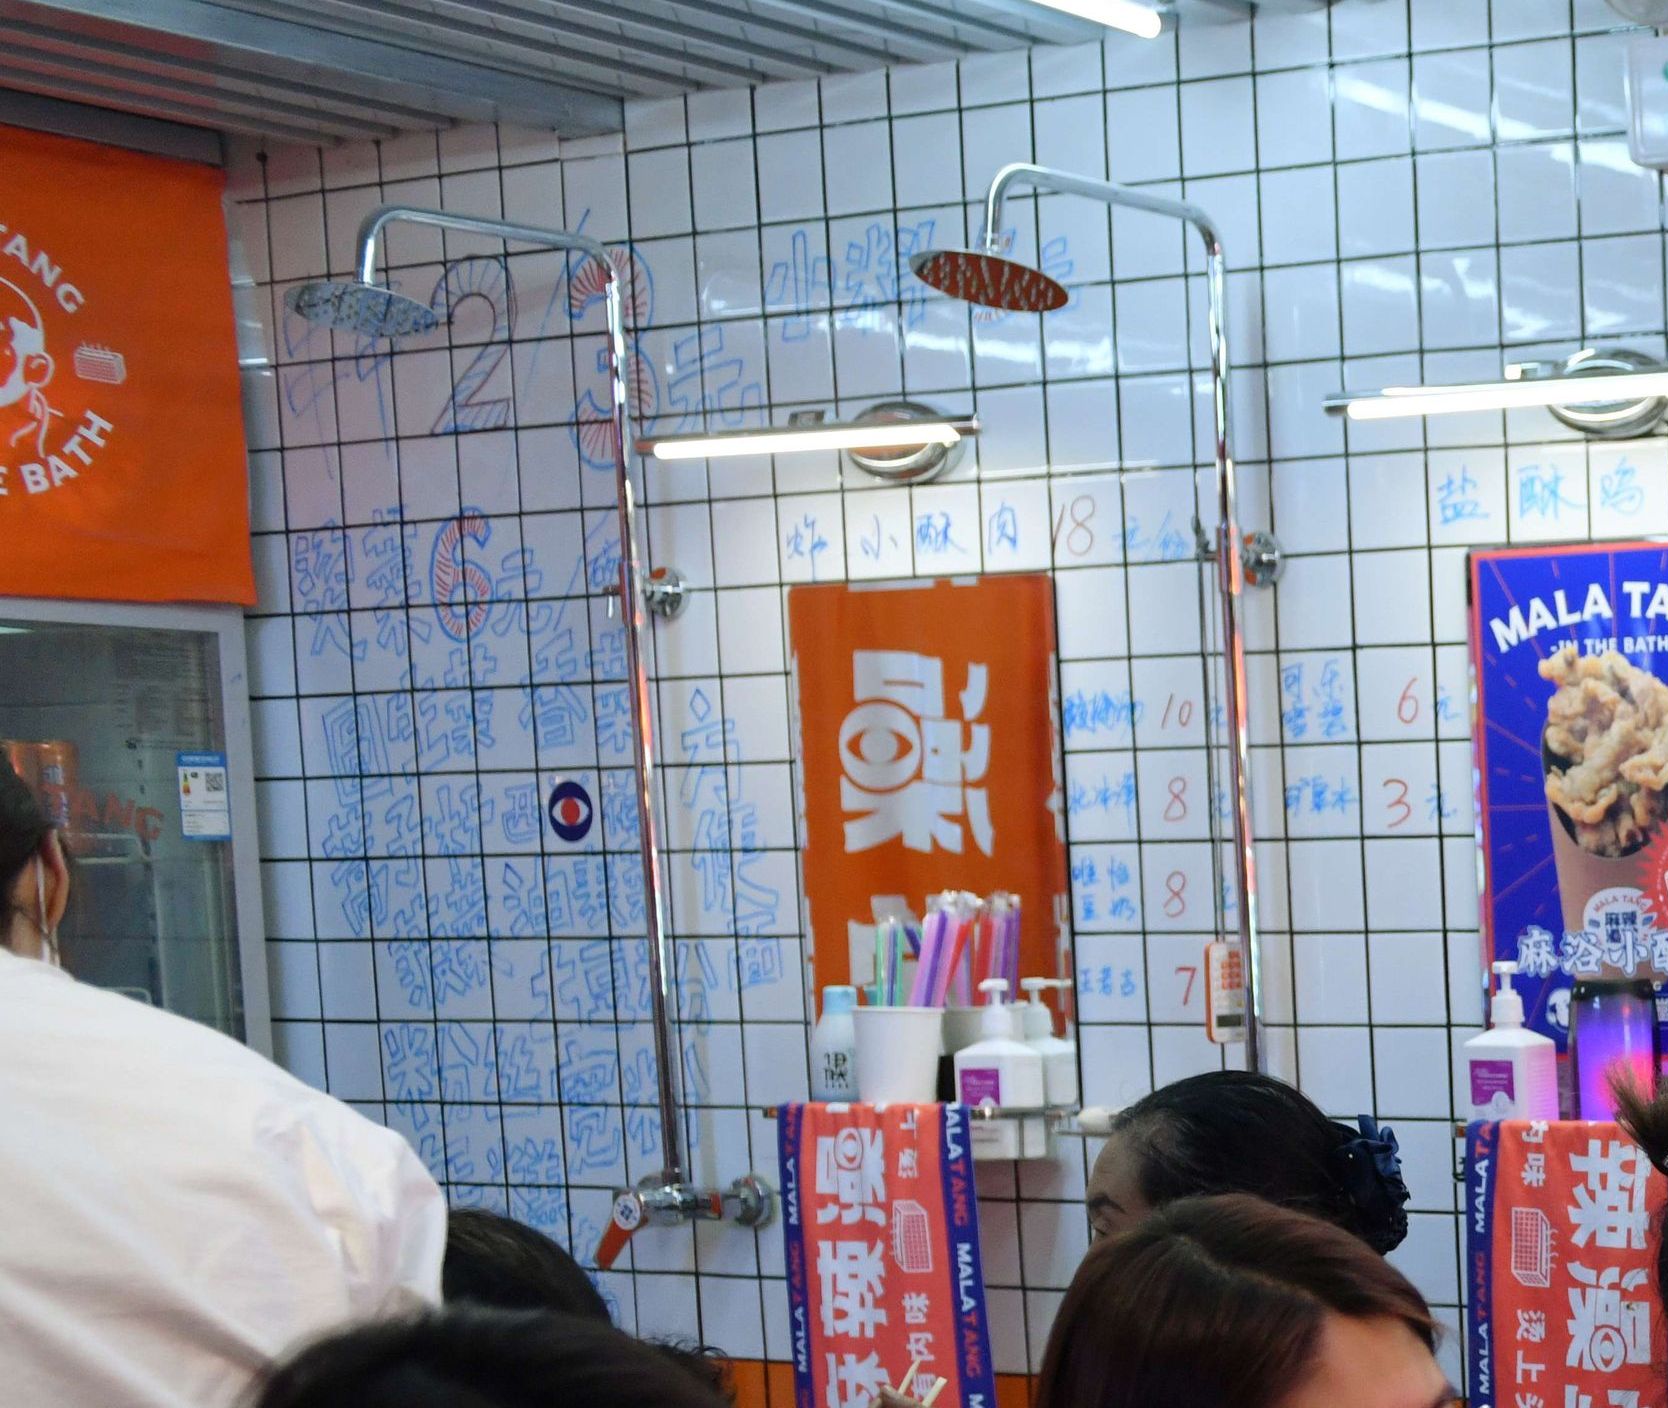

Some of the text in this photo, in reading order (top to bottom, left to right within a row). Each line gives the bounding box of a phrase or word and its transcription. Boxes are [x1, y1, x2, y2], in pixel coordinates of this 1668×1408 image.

[20, 409, 114, 494] BATH
[1436, 457, 1644, 526] 盐酥鸡
[1488, 582, 1615, 654] MALA
